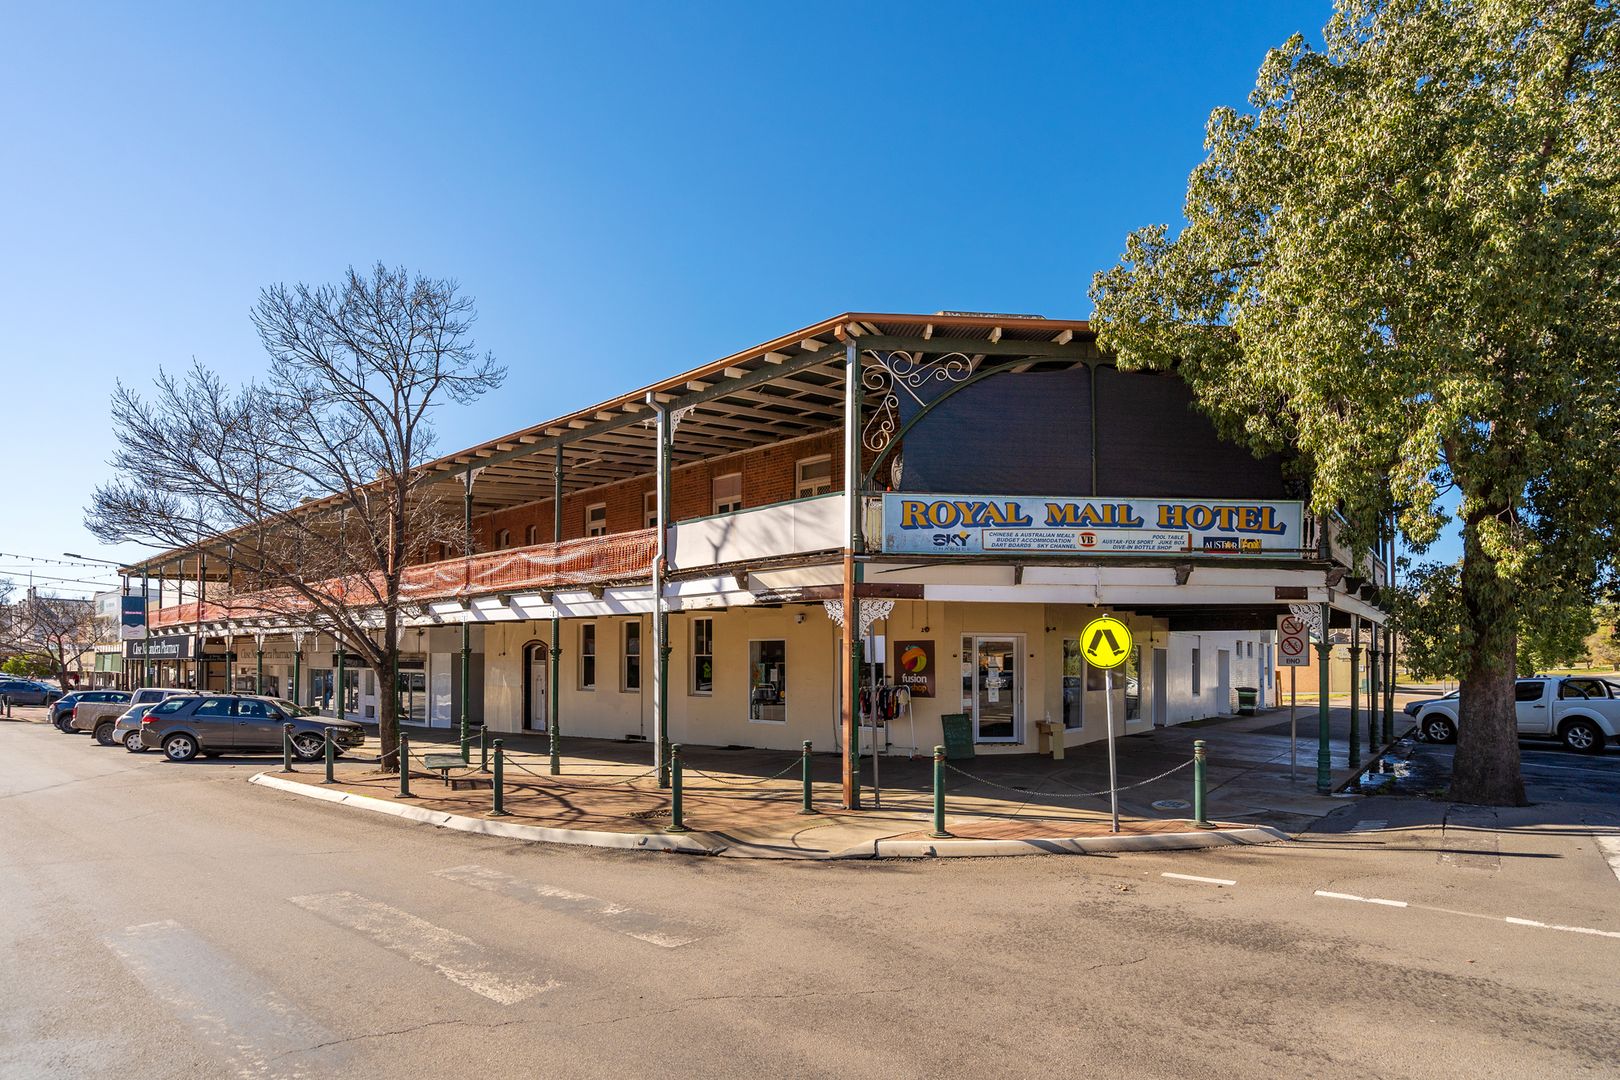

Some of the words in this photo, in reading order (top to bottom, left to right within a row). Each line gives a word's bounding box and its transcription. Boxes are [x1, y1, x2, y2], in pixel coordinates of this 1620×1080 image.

[900, 500, 1033, 529] ROYAL
[1044, 502, 1145, 528] MAIL
[1157, 504, 1287, 535] HOTEL
[932, 531, 971, 546] SKY
[1081, 536, 1094, 544] VB
[161, 640, 180, 658] Pharmacy
[902, 673, 928, 683] fusion
